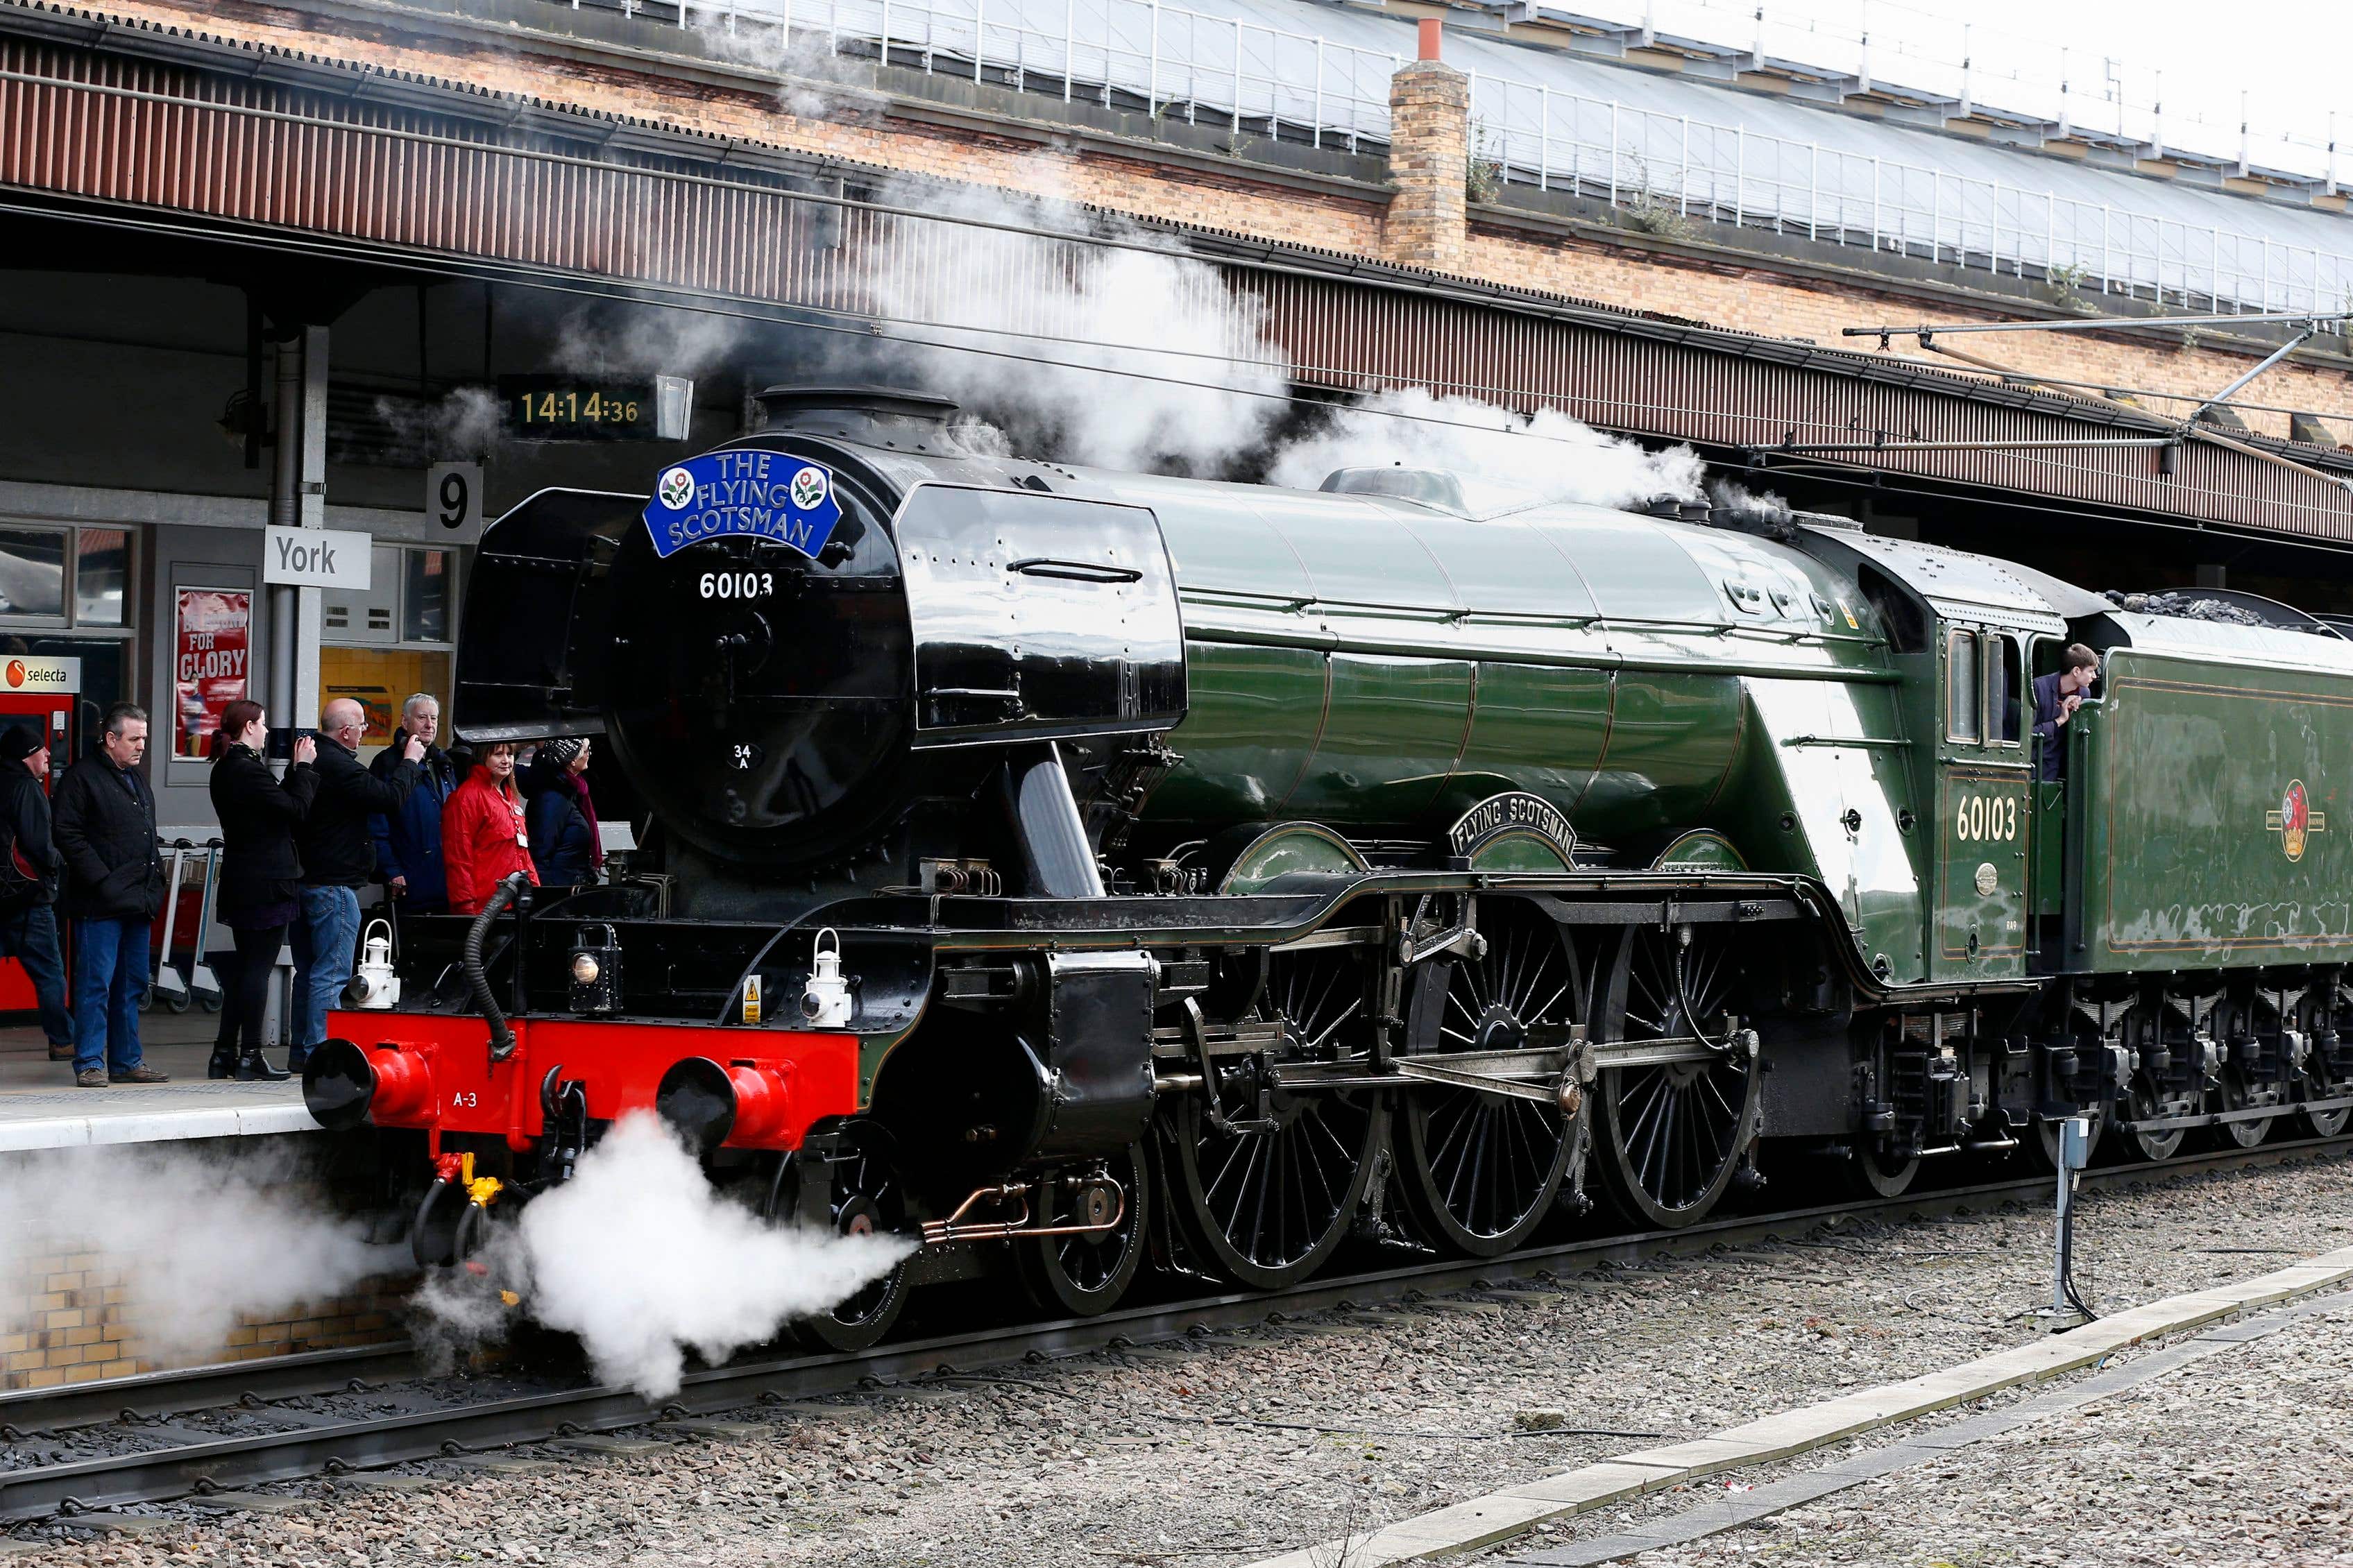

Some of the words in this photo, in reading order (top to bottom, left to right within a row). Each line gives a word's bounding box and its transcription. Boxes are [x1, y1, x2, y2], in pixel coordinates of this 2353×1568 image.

[522, 392, 638, 423] 14:14:36
[715, 454, 771, 479] THE
[439, 472, 468, 529] 9
[696, 480, 789, 509] FLYING
[668, 507, 813, 548] SCOTSMAN
[275, 536, 336, 574] York
[699, 572, 773, 599] 60103
[189, 632, 214, 651] FOR
[28, 668, 67, 682] selecta
[180, 649, 246, 681] GLORY
[734, 744, 751, 758] 34
[739, 758, 749, 769] A
[1456, 801, 1502, 852] FLYING
[1509, 798, 1572, 858] SCOTSMAN
[1957, 795, 2016, 842] 60103
[453, 1092, 477, 1107] A-3
